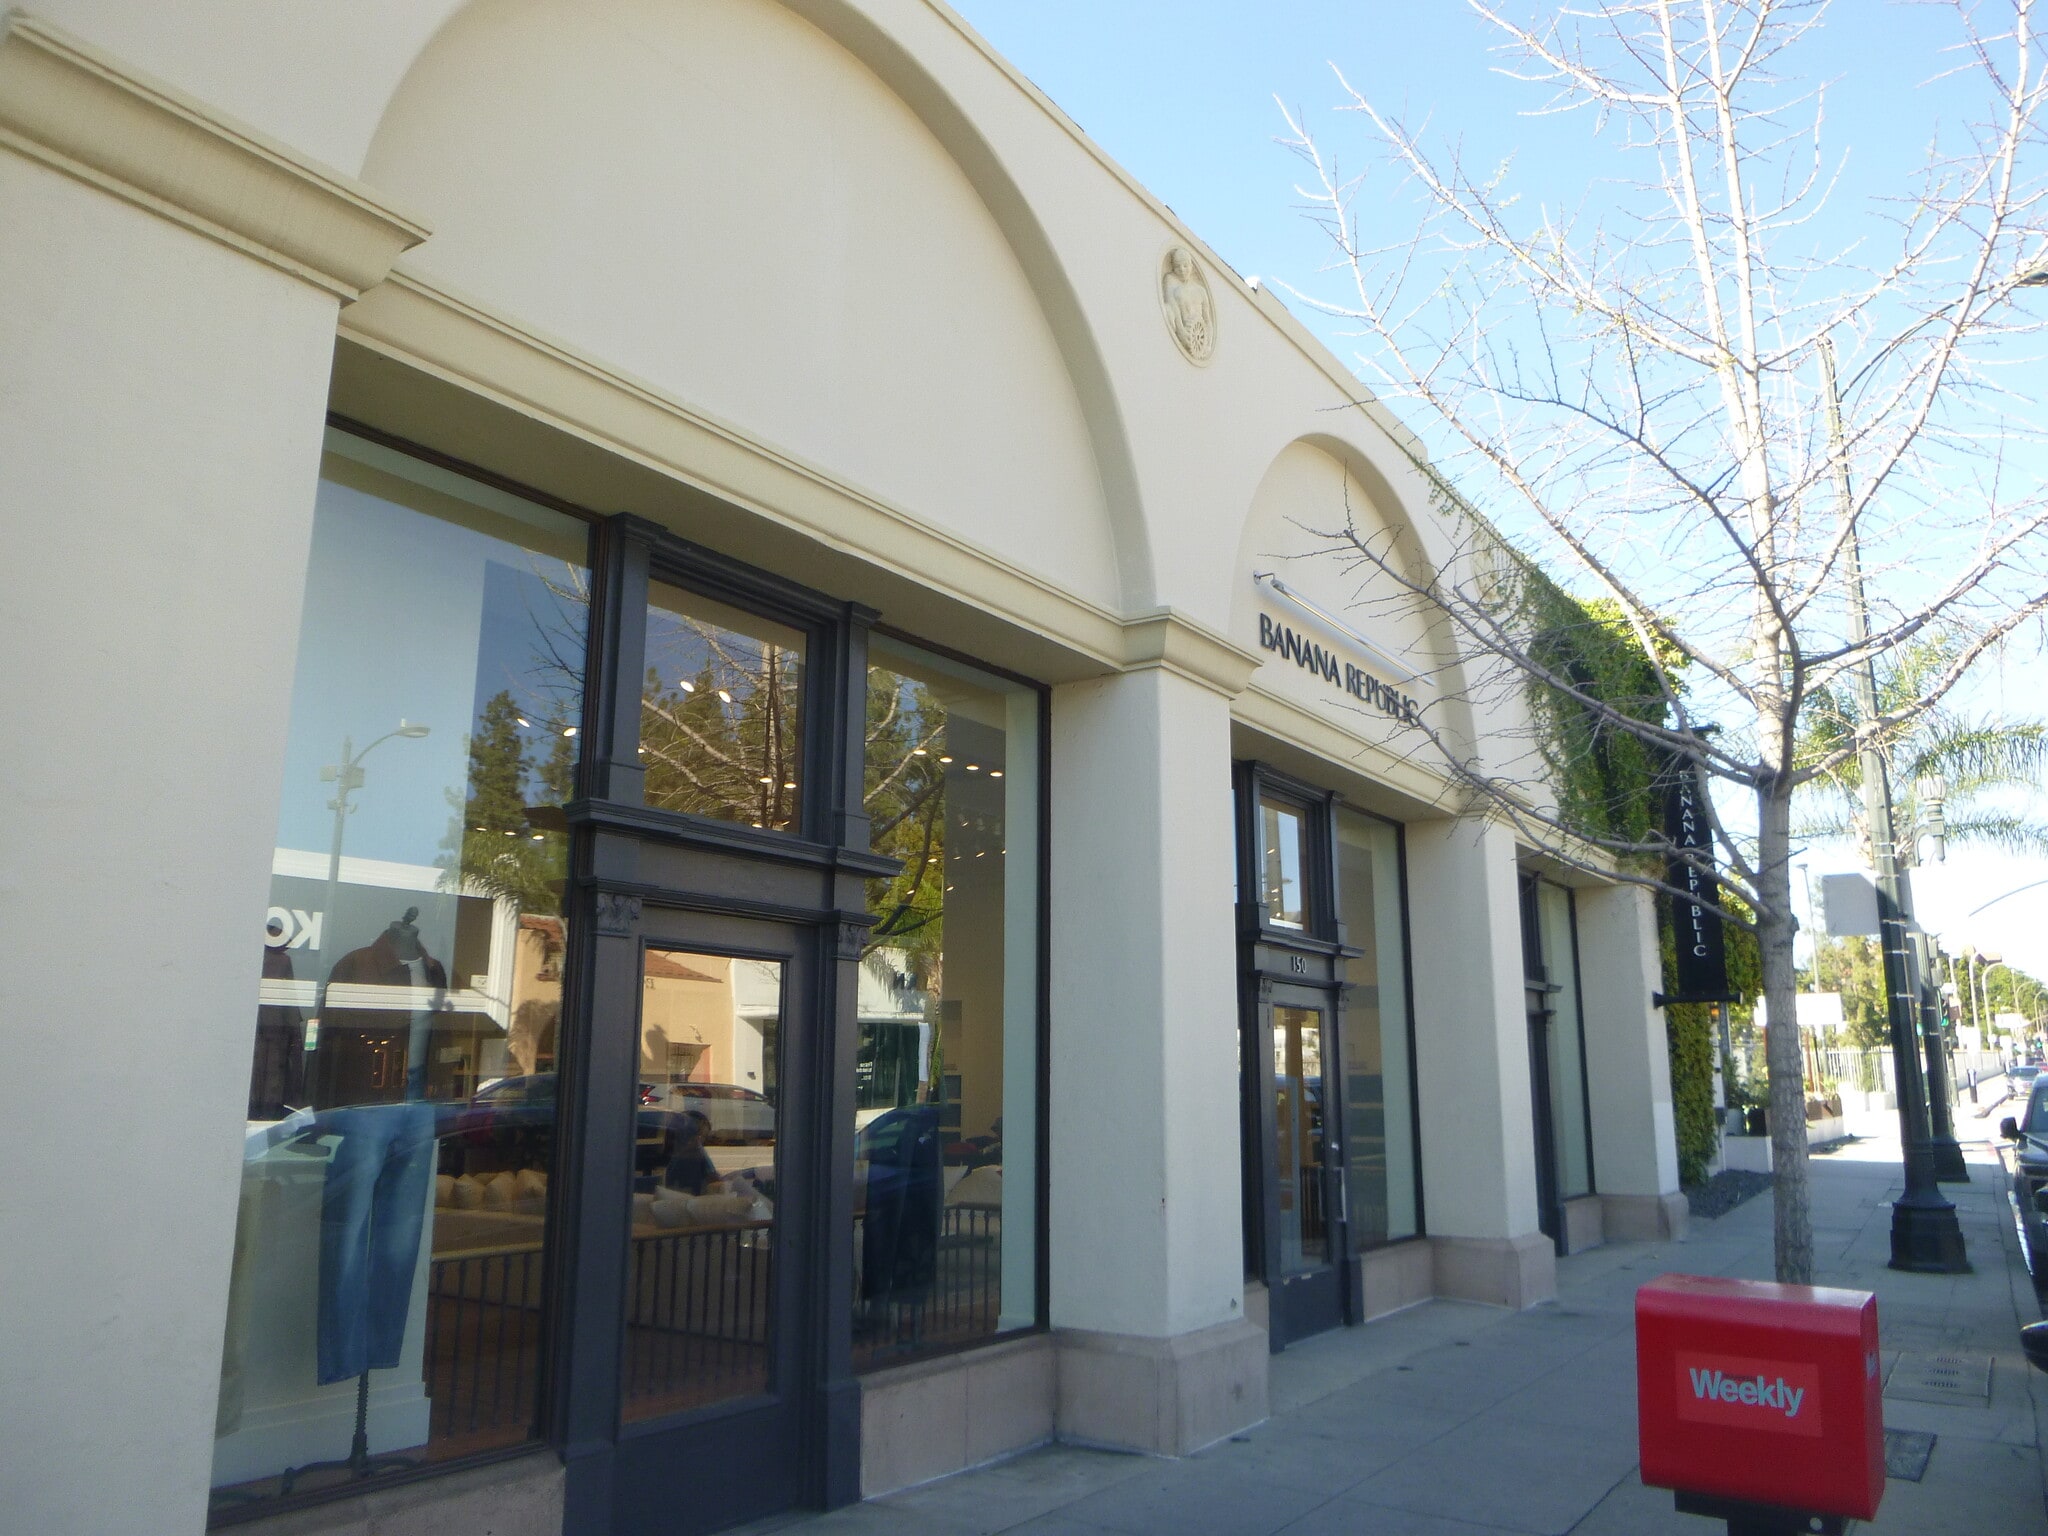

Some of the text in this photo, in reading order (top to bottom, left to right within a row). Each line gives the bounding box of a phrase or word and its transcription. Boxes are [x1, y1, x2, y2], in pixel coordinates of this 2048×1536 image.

[1260, 613, 1419, 728] BANANA REPUBLIC
[1291, 956, 1307, 974] 150
[1690, 1367, 1804, 1417] Weekly
